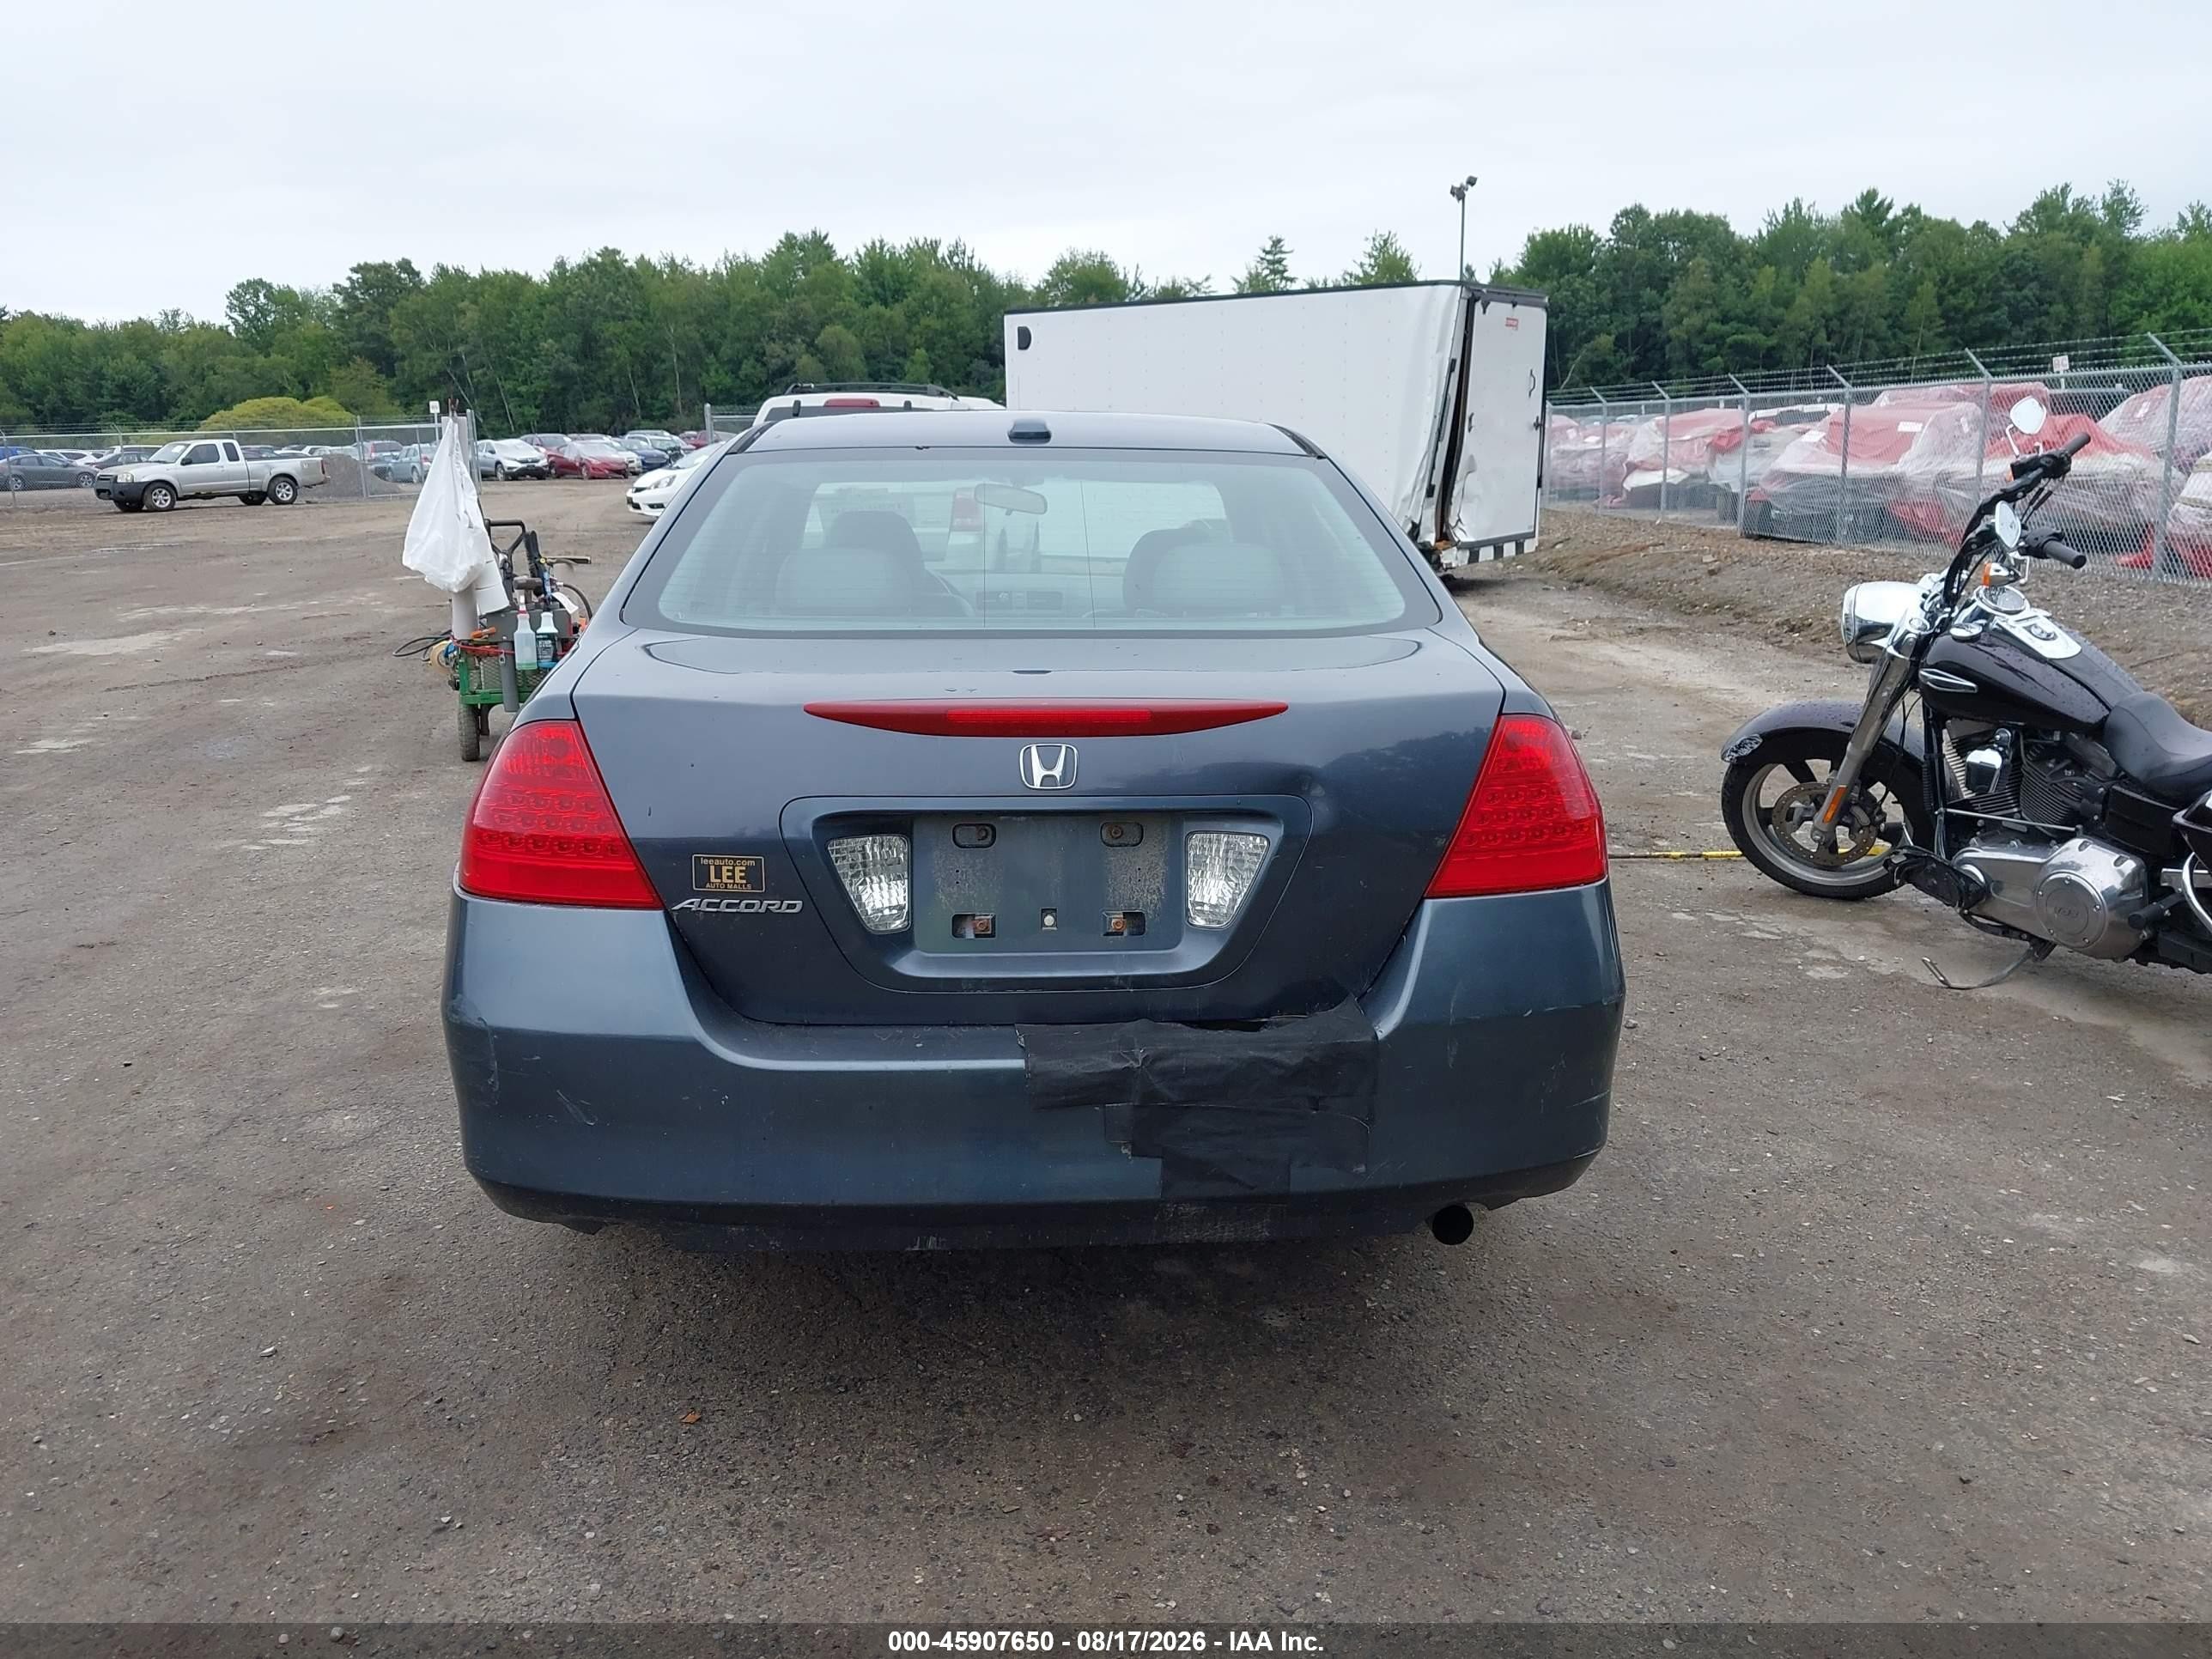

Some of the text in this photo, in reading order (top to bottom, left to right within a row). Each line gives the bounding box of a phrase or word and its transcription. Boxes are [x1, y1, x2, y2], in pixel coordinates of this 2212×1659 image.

[700, 857, 756, 866] leeauto.com
[709, 865, 747, 884] LEE
[672, 898, 804, 914] ACCORD
